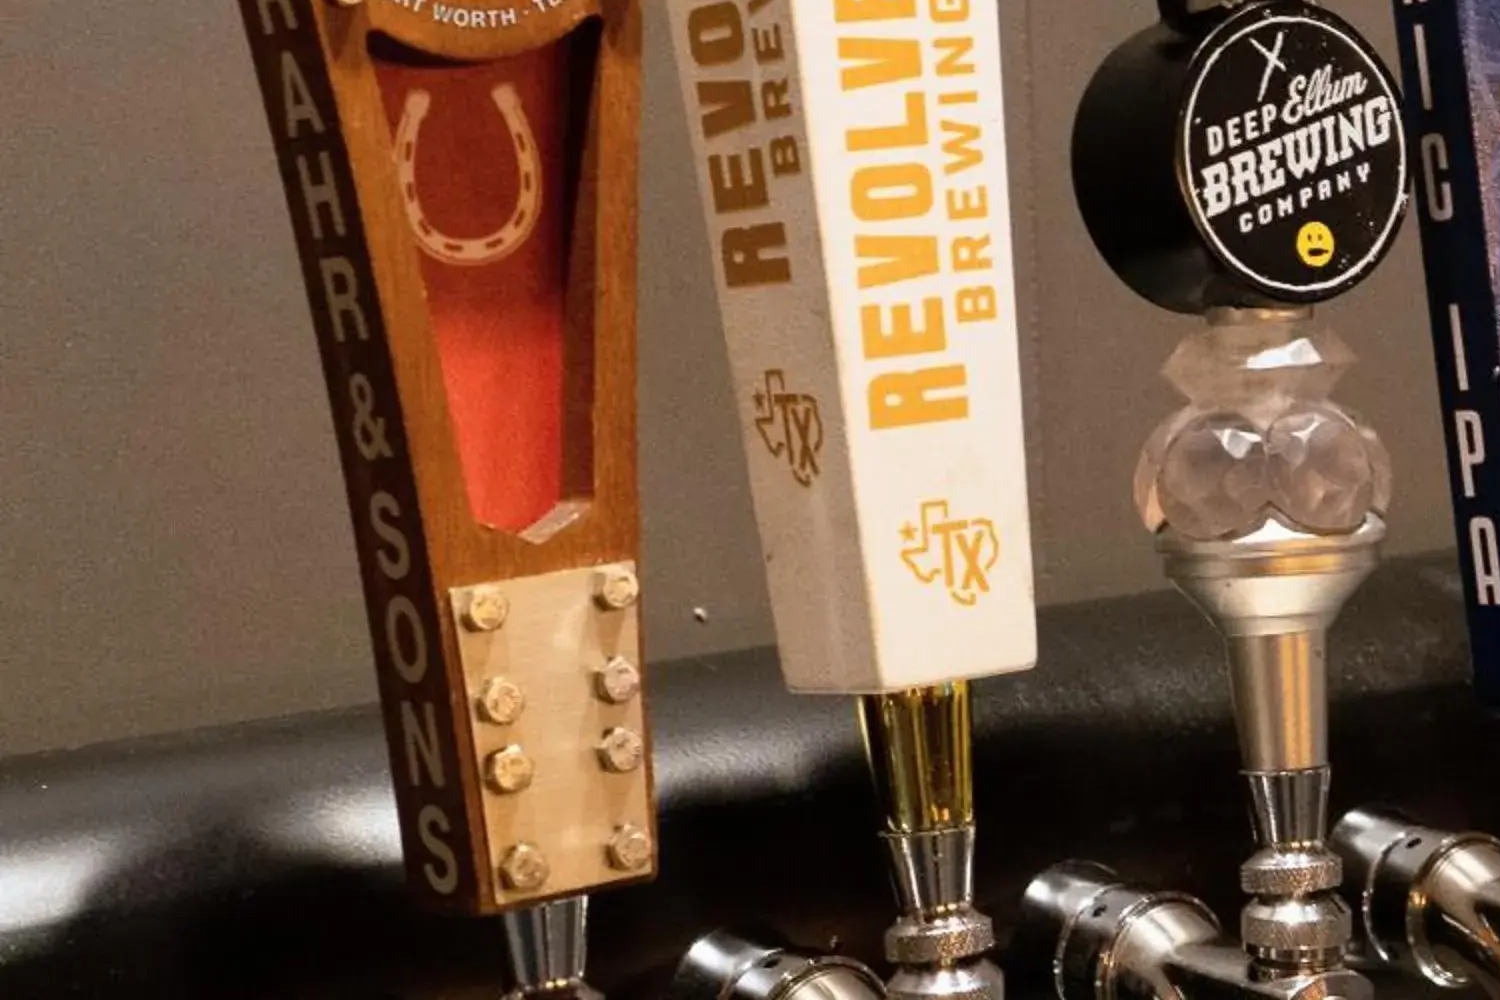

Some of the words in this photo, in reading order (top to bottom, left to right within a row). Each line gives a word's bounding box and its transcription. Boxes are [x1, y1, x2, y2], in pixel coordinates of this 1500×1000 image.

[432, 4, 517, 29] WORTH
[1205, 103, 1278, 156] DEEP
[1281, 63, 1369, 125] Ellum
[1200, 95, 1392, 219] BREWING
[1239, 162, 1372, 233] COMPANY
[349, 372, 394, 460] &
[931, 519, 990, 593] TX
[369, 491, 457, 894] SONS
